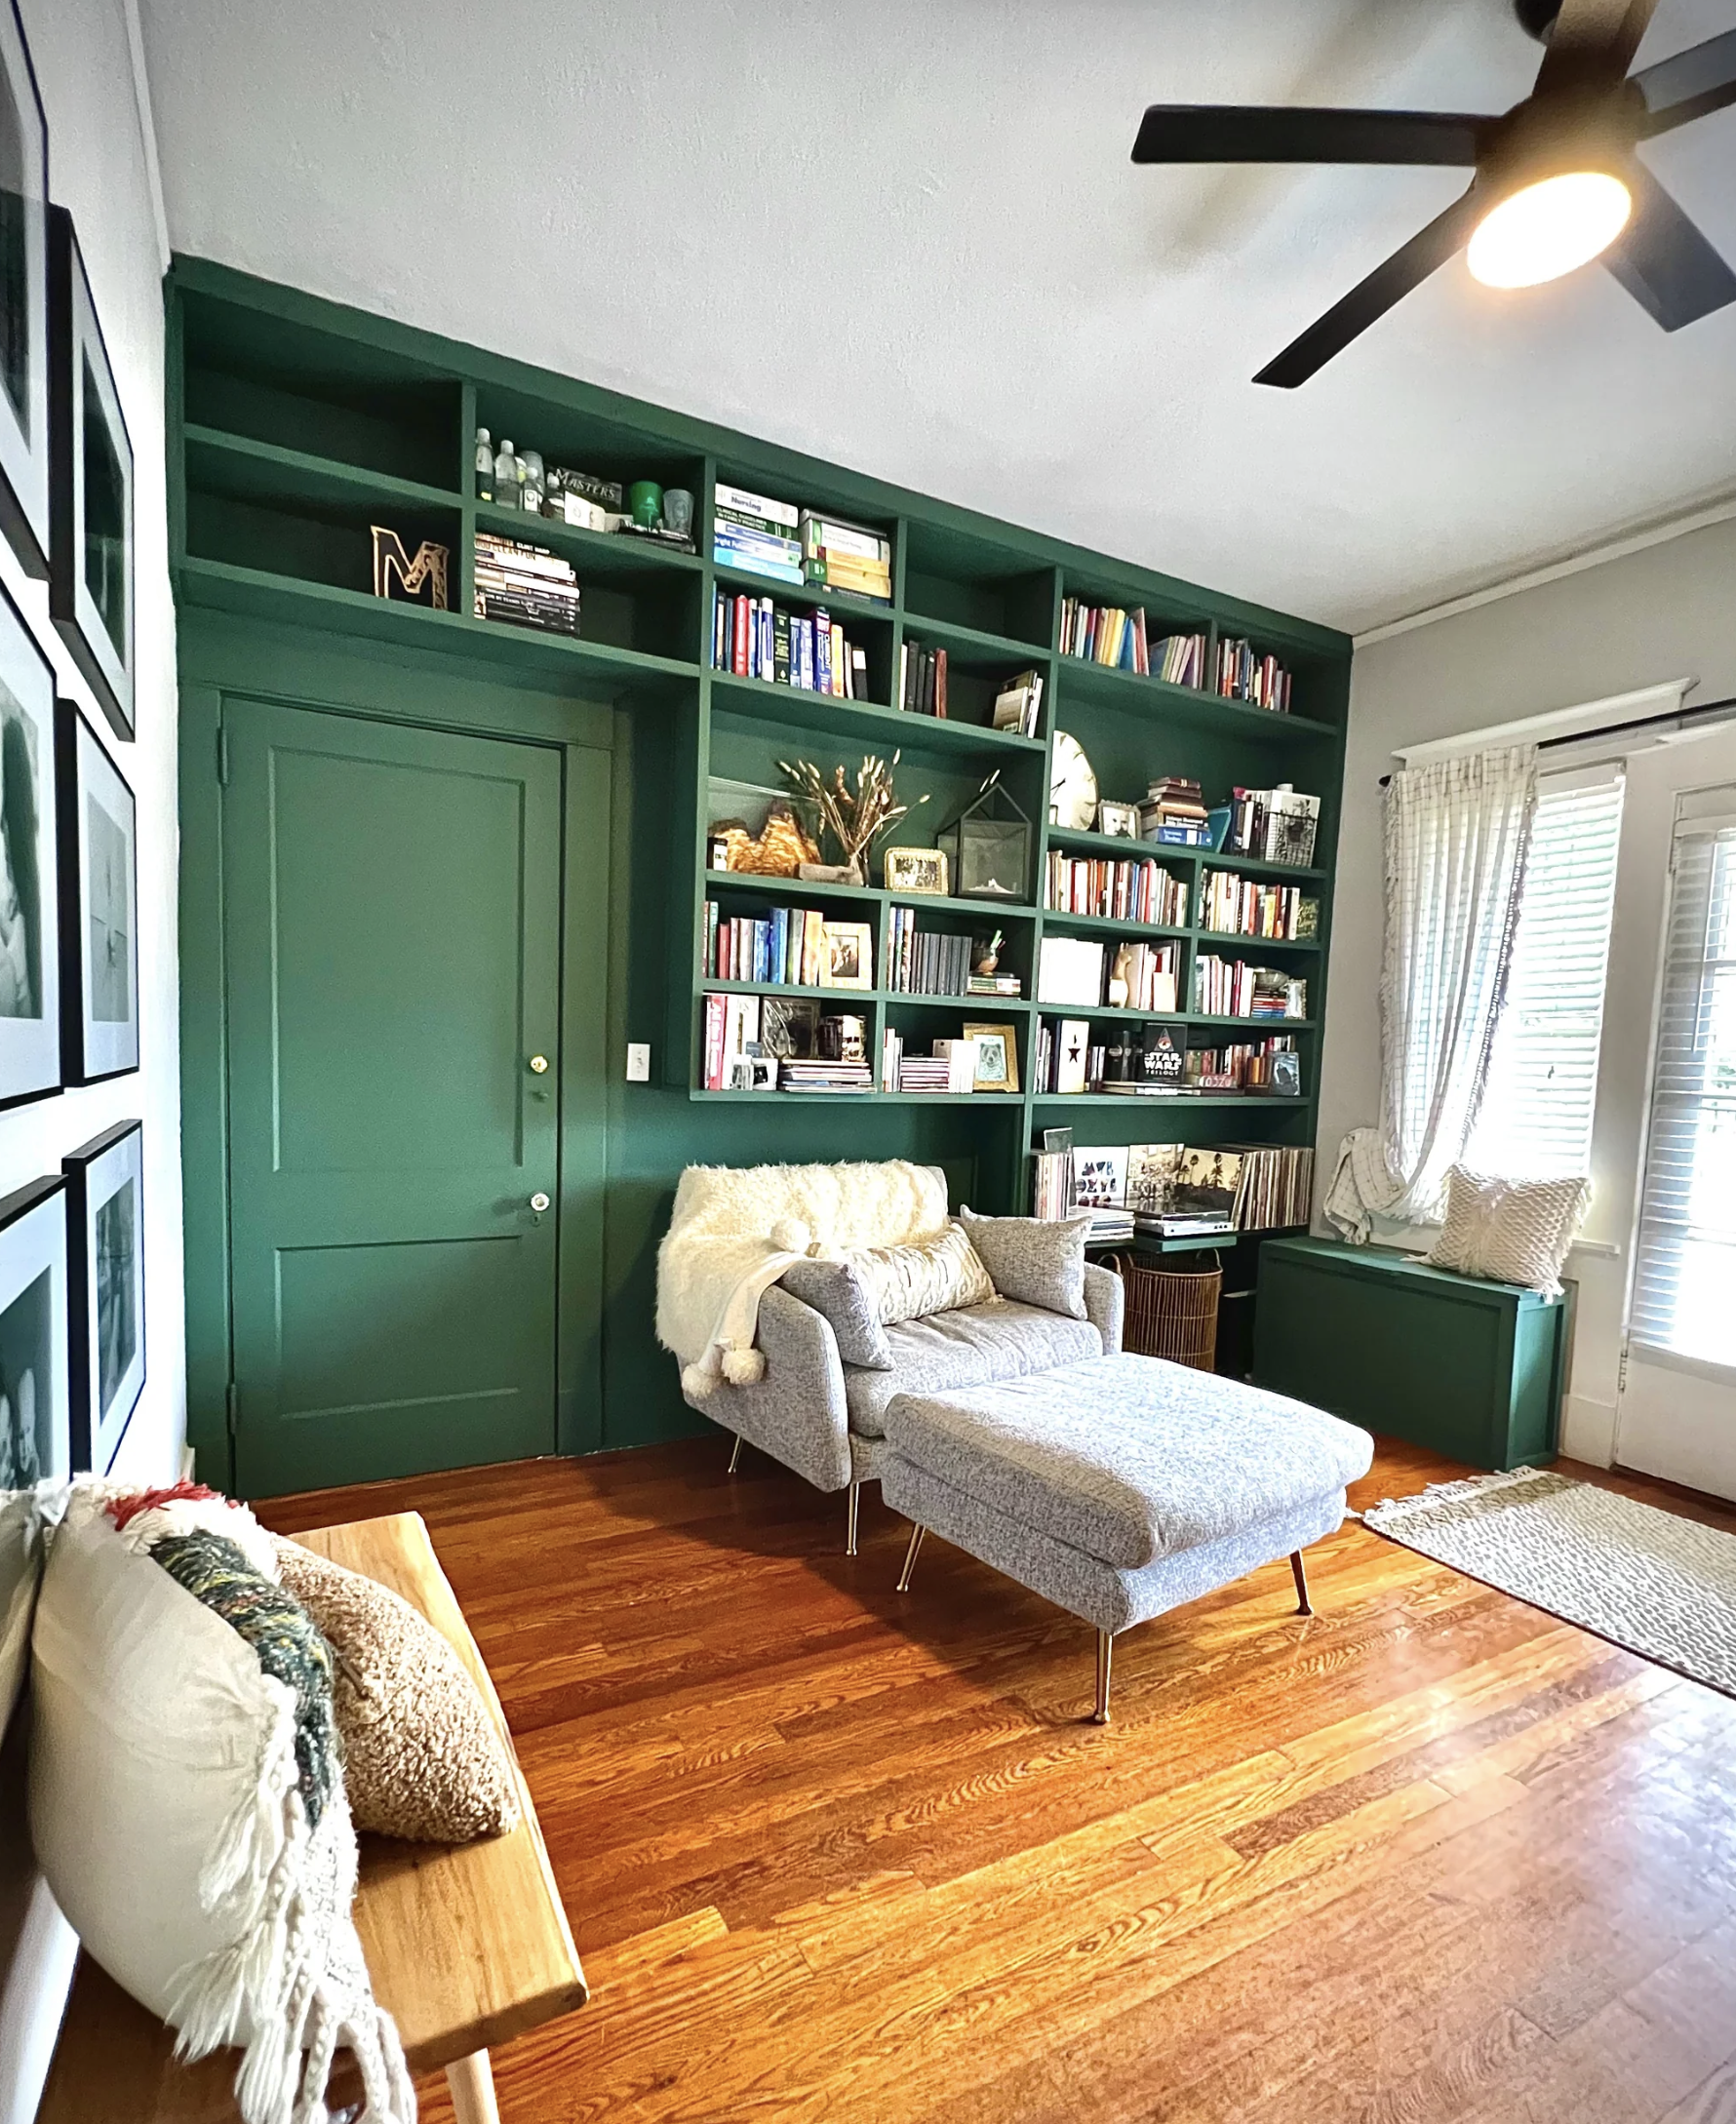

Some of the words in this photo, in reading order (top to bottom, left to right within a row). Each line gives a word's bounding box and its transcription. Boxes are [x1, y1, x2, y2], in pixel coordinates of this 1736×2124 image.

[730, 495, 762, 512] Nursing
[1144, 1051, 1183, 1062] STAR
[1144, 1060, 1182, 1071] WARS
